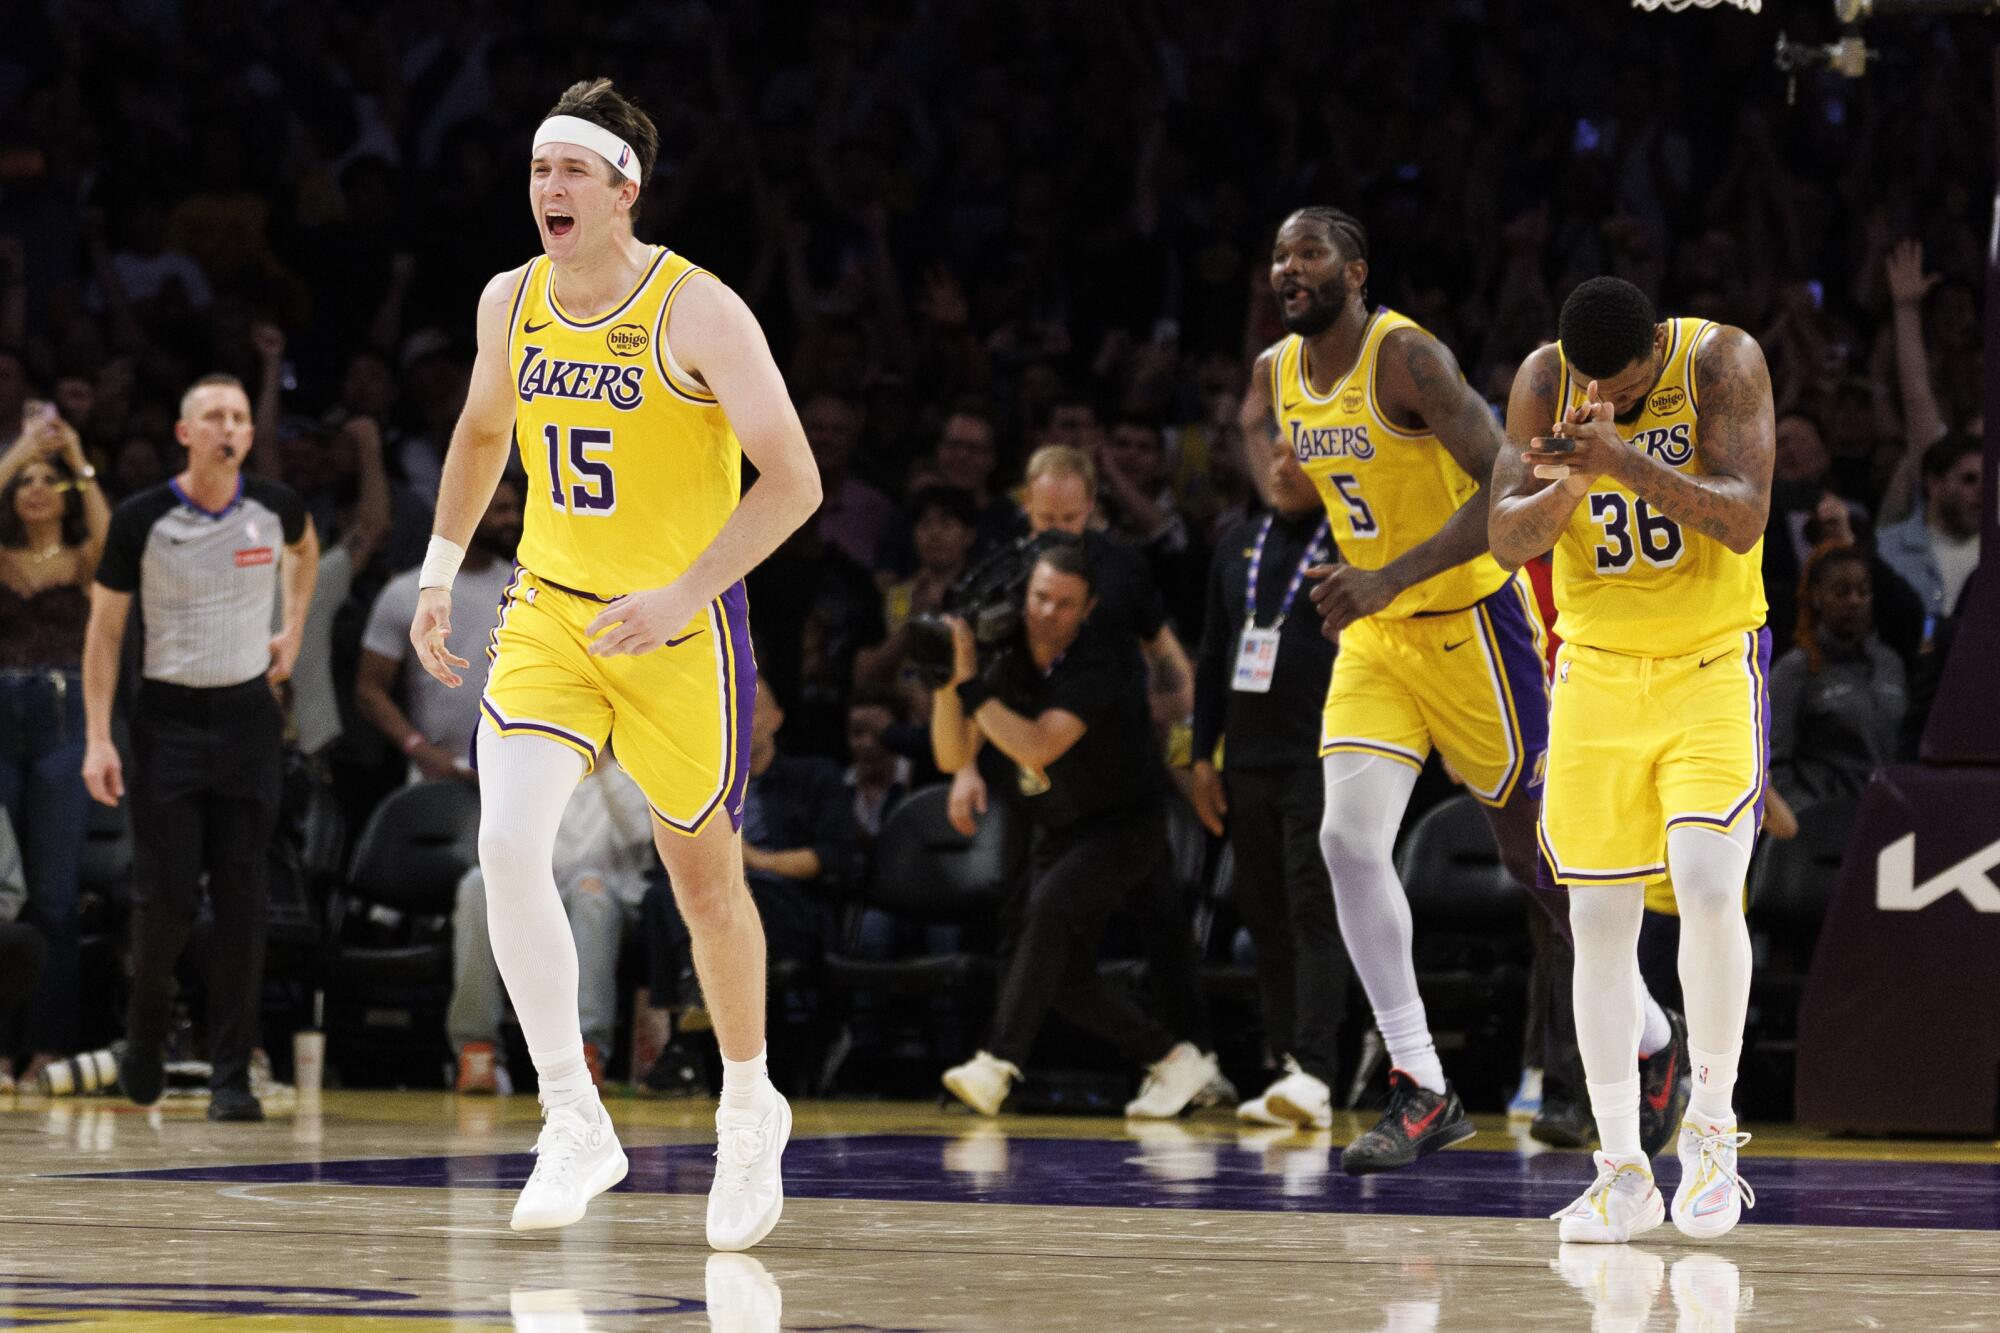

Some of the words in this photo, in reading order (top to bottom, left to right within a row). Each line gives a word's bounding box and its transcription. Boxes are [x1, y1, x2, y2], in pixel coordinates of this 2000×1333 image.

[611, 333, 647, 348] bibigo
[518, 345, 643, 412] LAKERS
[1652, 393, 1684, 408] bibigo
[544, 424, 616, 517] 15
[1290, 419, 1376, 465] LAKERS
[1329, 474, 1380, 538] 5
[1589, 492, 1685, 575] 36
